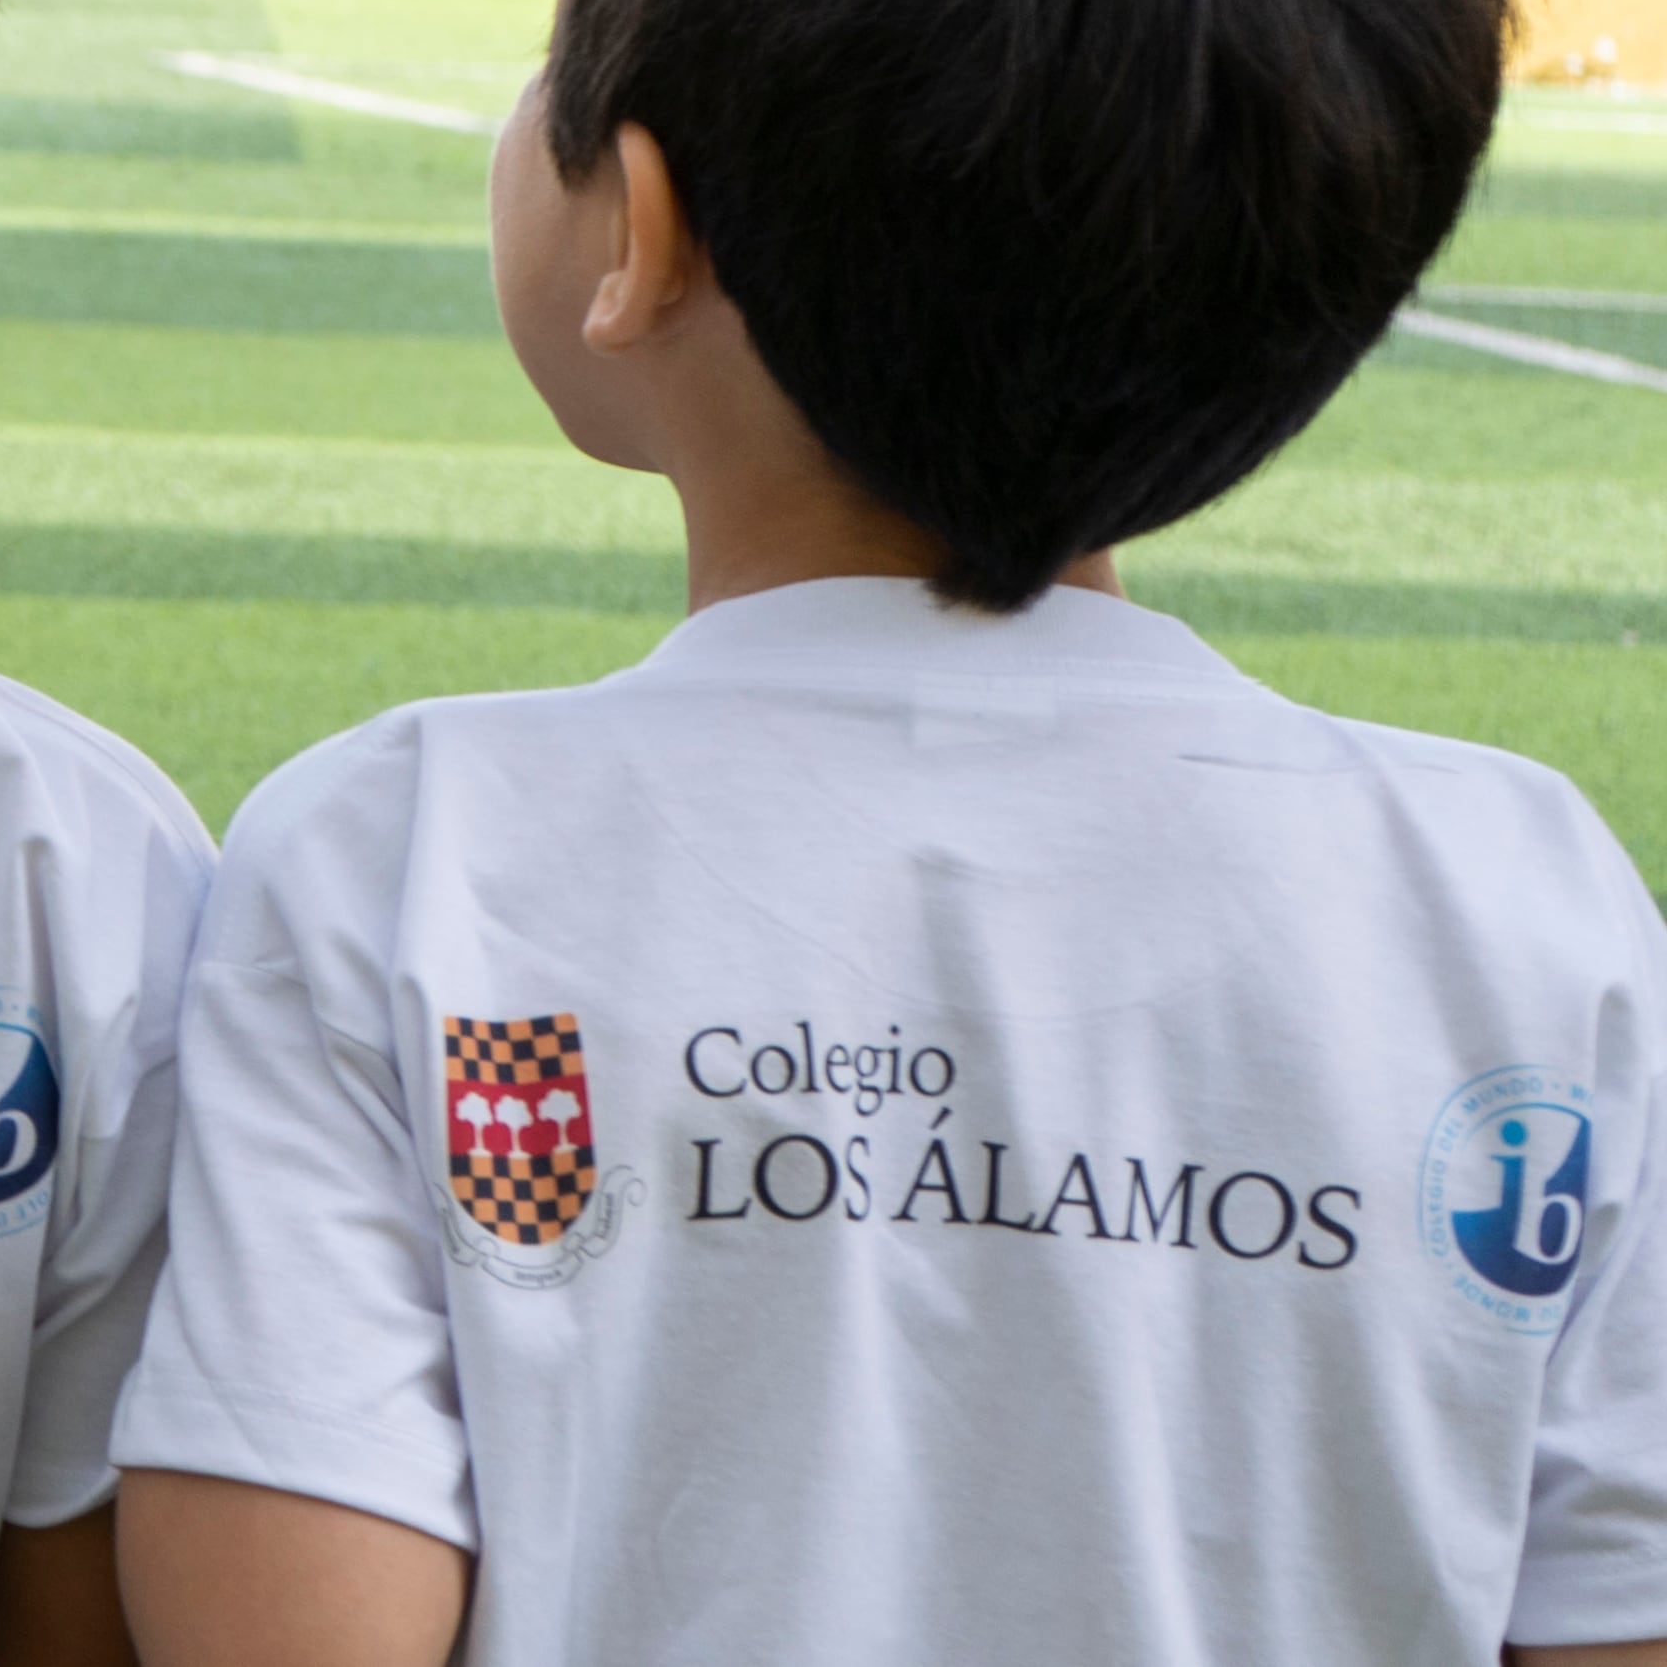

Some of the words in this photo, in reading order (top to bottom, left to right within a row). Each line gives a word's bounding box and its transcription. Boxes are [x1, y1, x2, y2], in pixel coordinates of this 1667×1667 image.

[684, 1020, 956, 1118] Colegio
[687, 1133, 872, 1222] LOS
[890, 1106, 1363, 1270] ÁLAMOS
